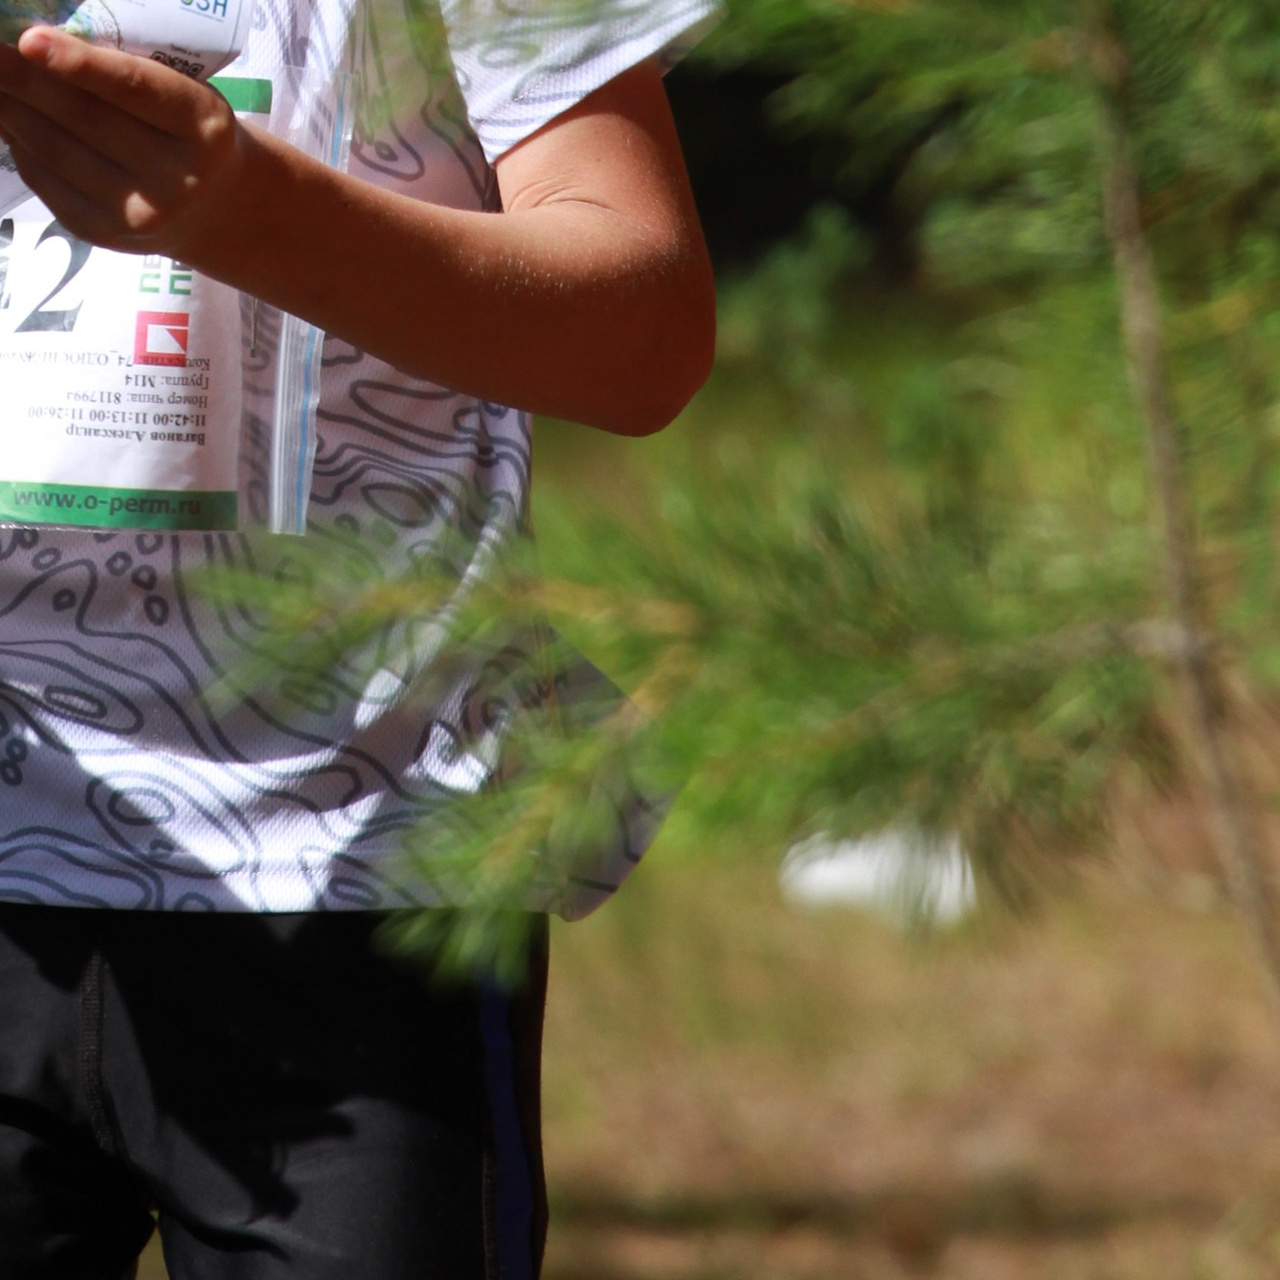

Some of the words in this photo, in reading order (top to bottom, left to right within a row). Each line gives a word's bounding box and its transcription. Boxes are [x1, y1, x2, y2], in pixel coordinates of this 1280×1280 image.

[125, 375, 155, 388] М14
[161, 374, 210, 390] Группа:
[66, 391, 121, 404] 8117994
[126, 393, 163, 405] чипа:
[168, 392, 208, 407] Номер
[28, 406, 84, 420] 11:26:00
[89, 410, 148, 425] 11:13:00
[153, 413, 206, 427] 11:42:00
[66, 424, 146, 441] Александр
[151, 431, 205, 445] Ваганов
[12, 488, 201, 516] www.o-perm.ru
